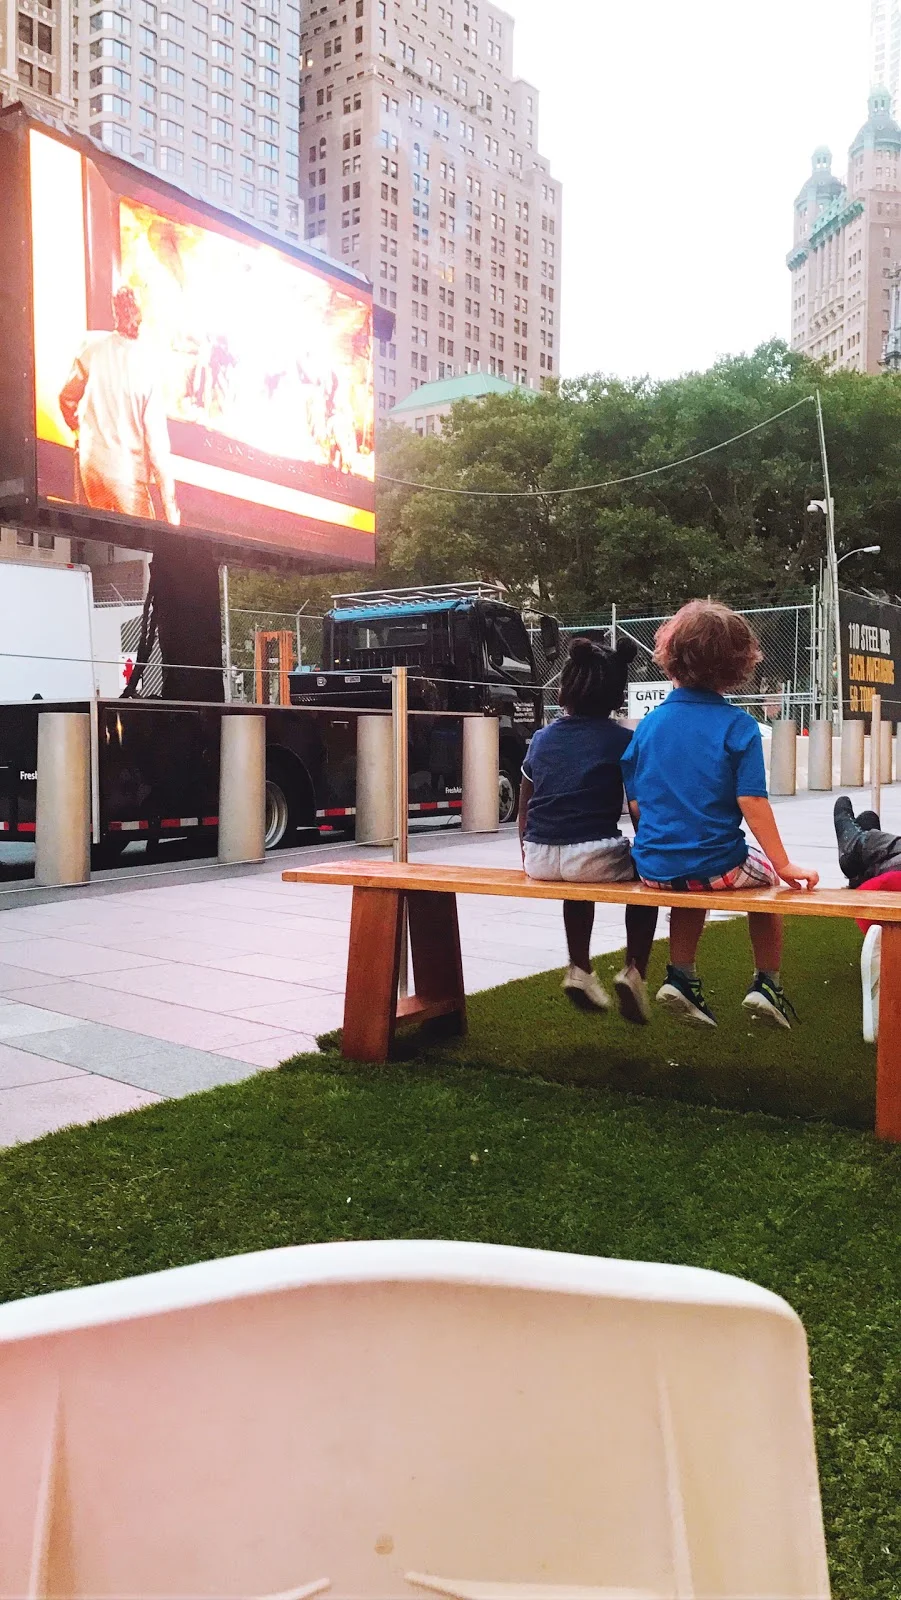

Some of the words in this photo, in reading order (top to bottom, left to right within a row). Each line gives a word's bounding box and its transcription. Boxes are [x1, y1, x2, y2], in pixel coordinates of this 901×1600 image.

[848, 622, 860, 650] 110
[861, 624, 880, 653] STEEL
[636, 690, 665, 701] GATE
